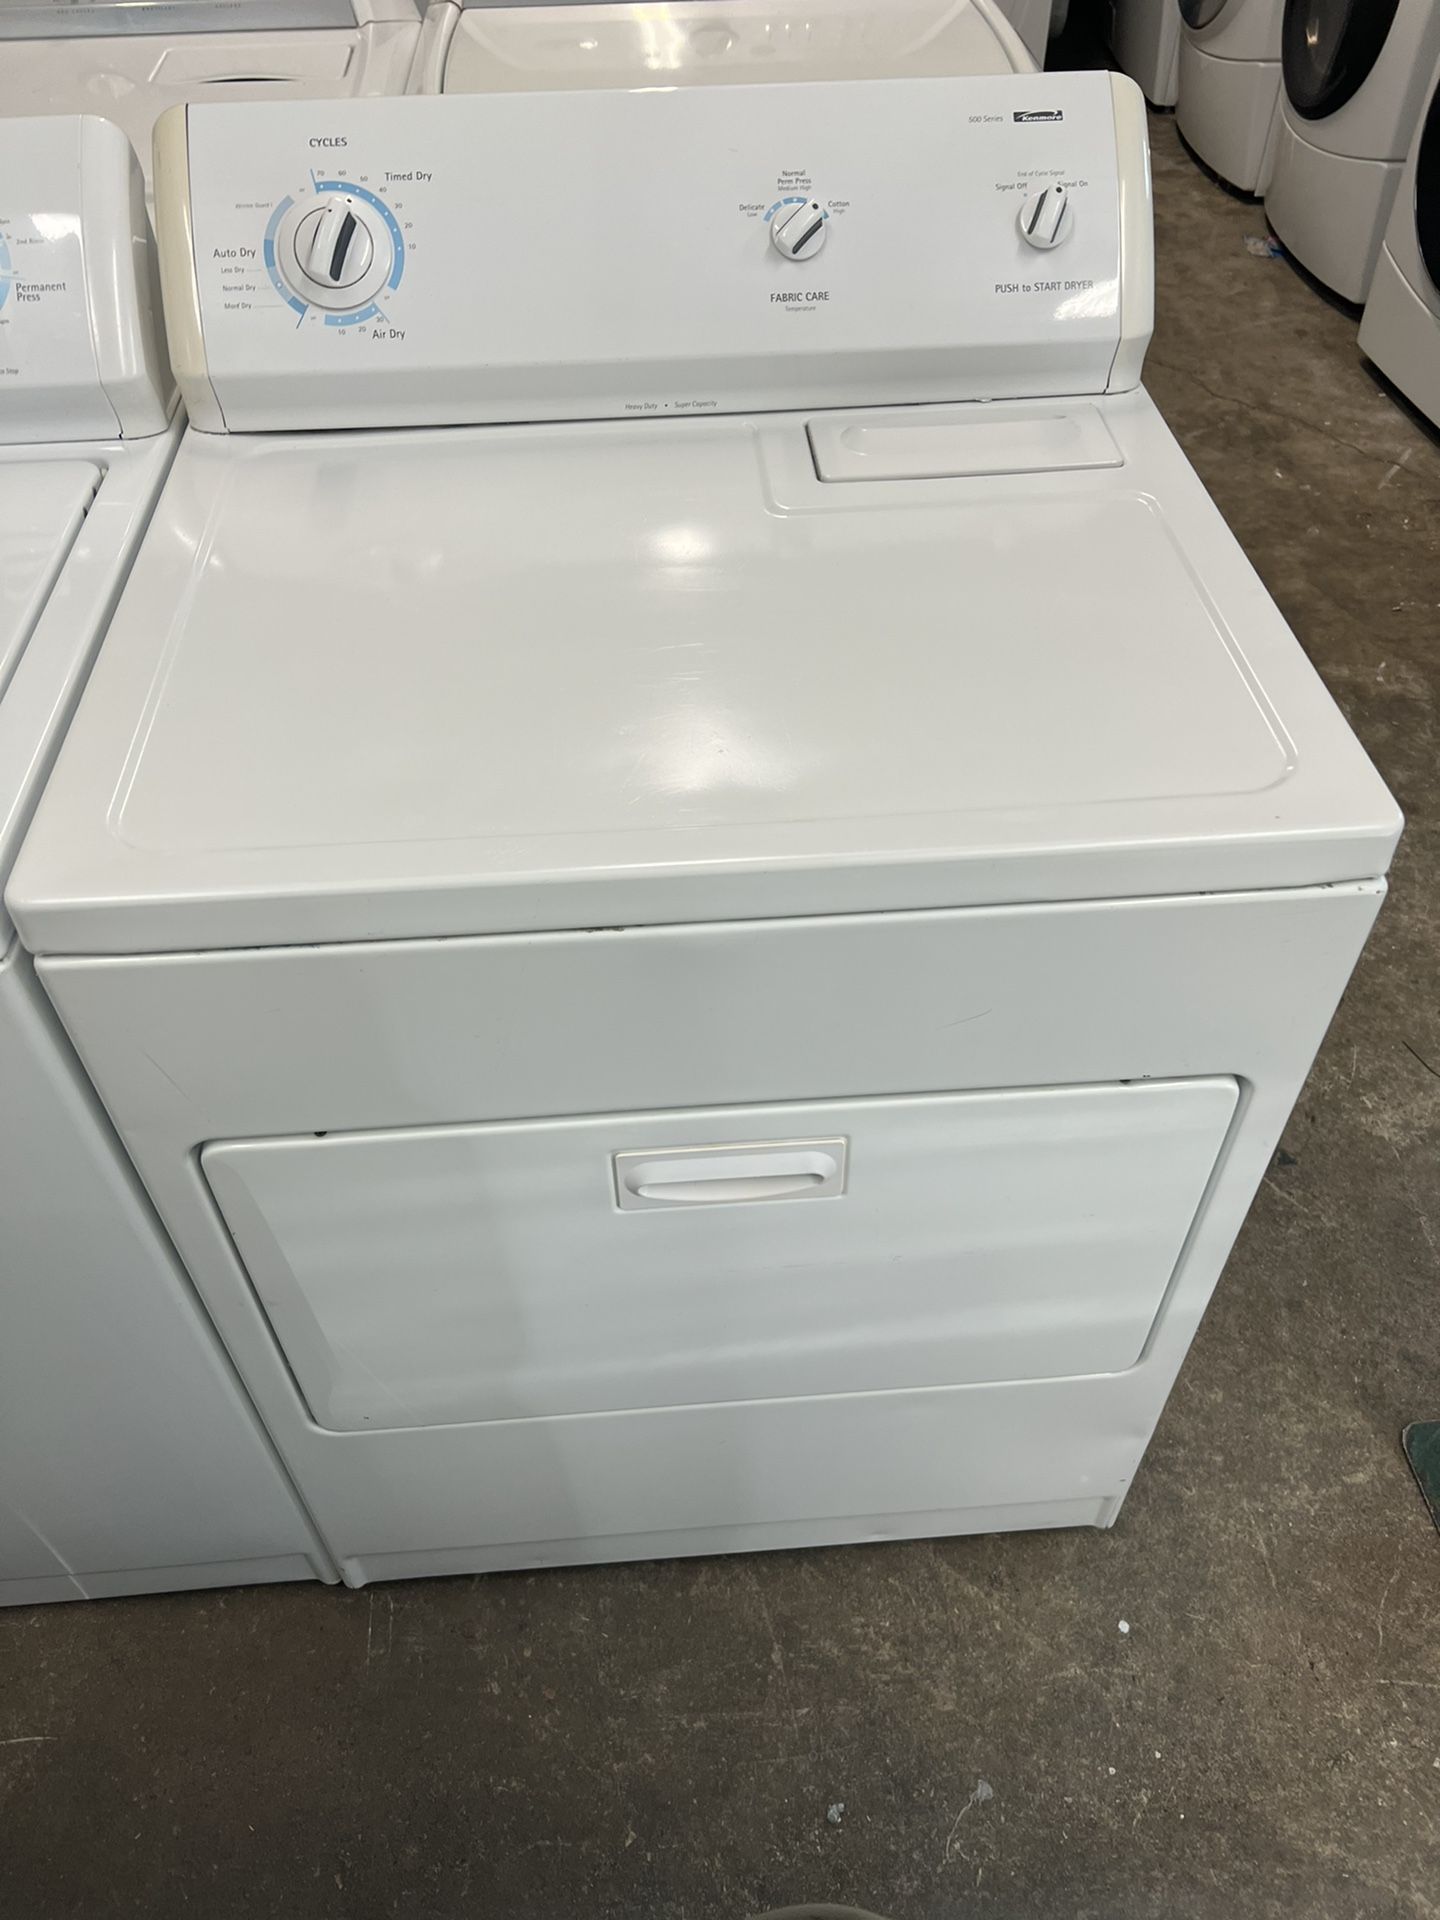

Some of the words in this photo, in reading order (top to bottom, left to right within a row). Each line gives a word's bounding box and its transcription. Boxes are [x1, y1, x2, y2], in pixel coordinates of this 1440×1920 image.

[983, 114, 1004, 123] Series
[309, 137, 348, 148] CYCLES
[385, 172, 413, 181] Timed
[416, 171, 433, 182] Dry
[995, 183, 1015, 192] Signal
[1017, 182, 1028, 190] Off
[739, 204, 765, 212] Delicate
[828, 200, 850, 208] Cotton
[408, 242, 417, 250] 10
[213, 248, 237, 258] Auto
[239, 247, 257, 259] Dry
[220, 266, 233, 274] Less
[234, 266, 245, 274] Dry
[15, 282, 66, 292] Permanent
[222, 284, 244, 292] Normal
[245, 284, 256, 292] Dry
[995, 284, 1019, 294] PUSH
[1022, 284, 1032, 293] to
[1034, 281, 1062, 292] START
[1065, 280, 1094, 290] DRYER
[16, 292, 41, 302] Press
[770, 293, 803, 303] FABRIC
[805, 292, 830, 302] CARE
[241, 302, 252, 310] Dry
[785, 305, 816, 313] Temperature
[372, 330, 386, 340] Air
[389, 329, 406, 341] Dry
[644, 402, 658, 410] Duty
[692, 401, 718, 409] Capacity
